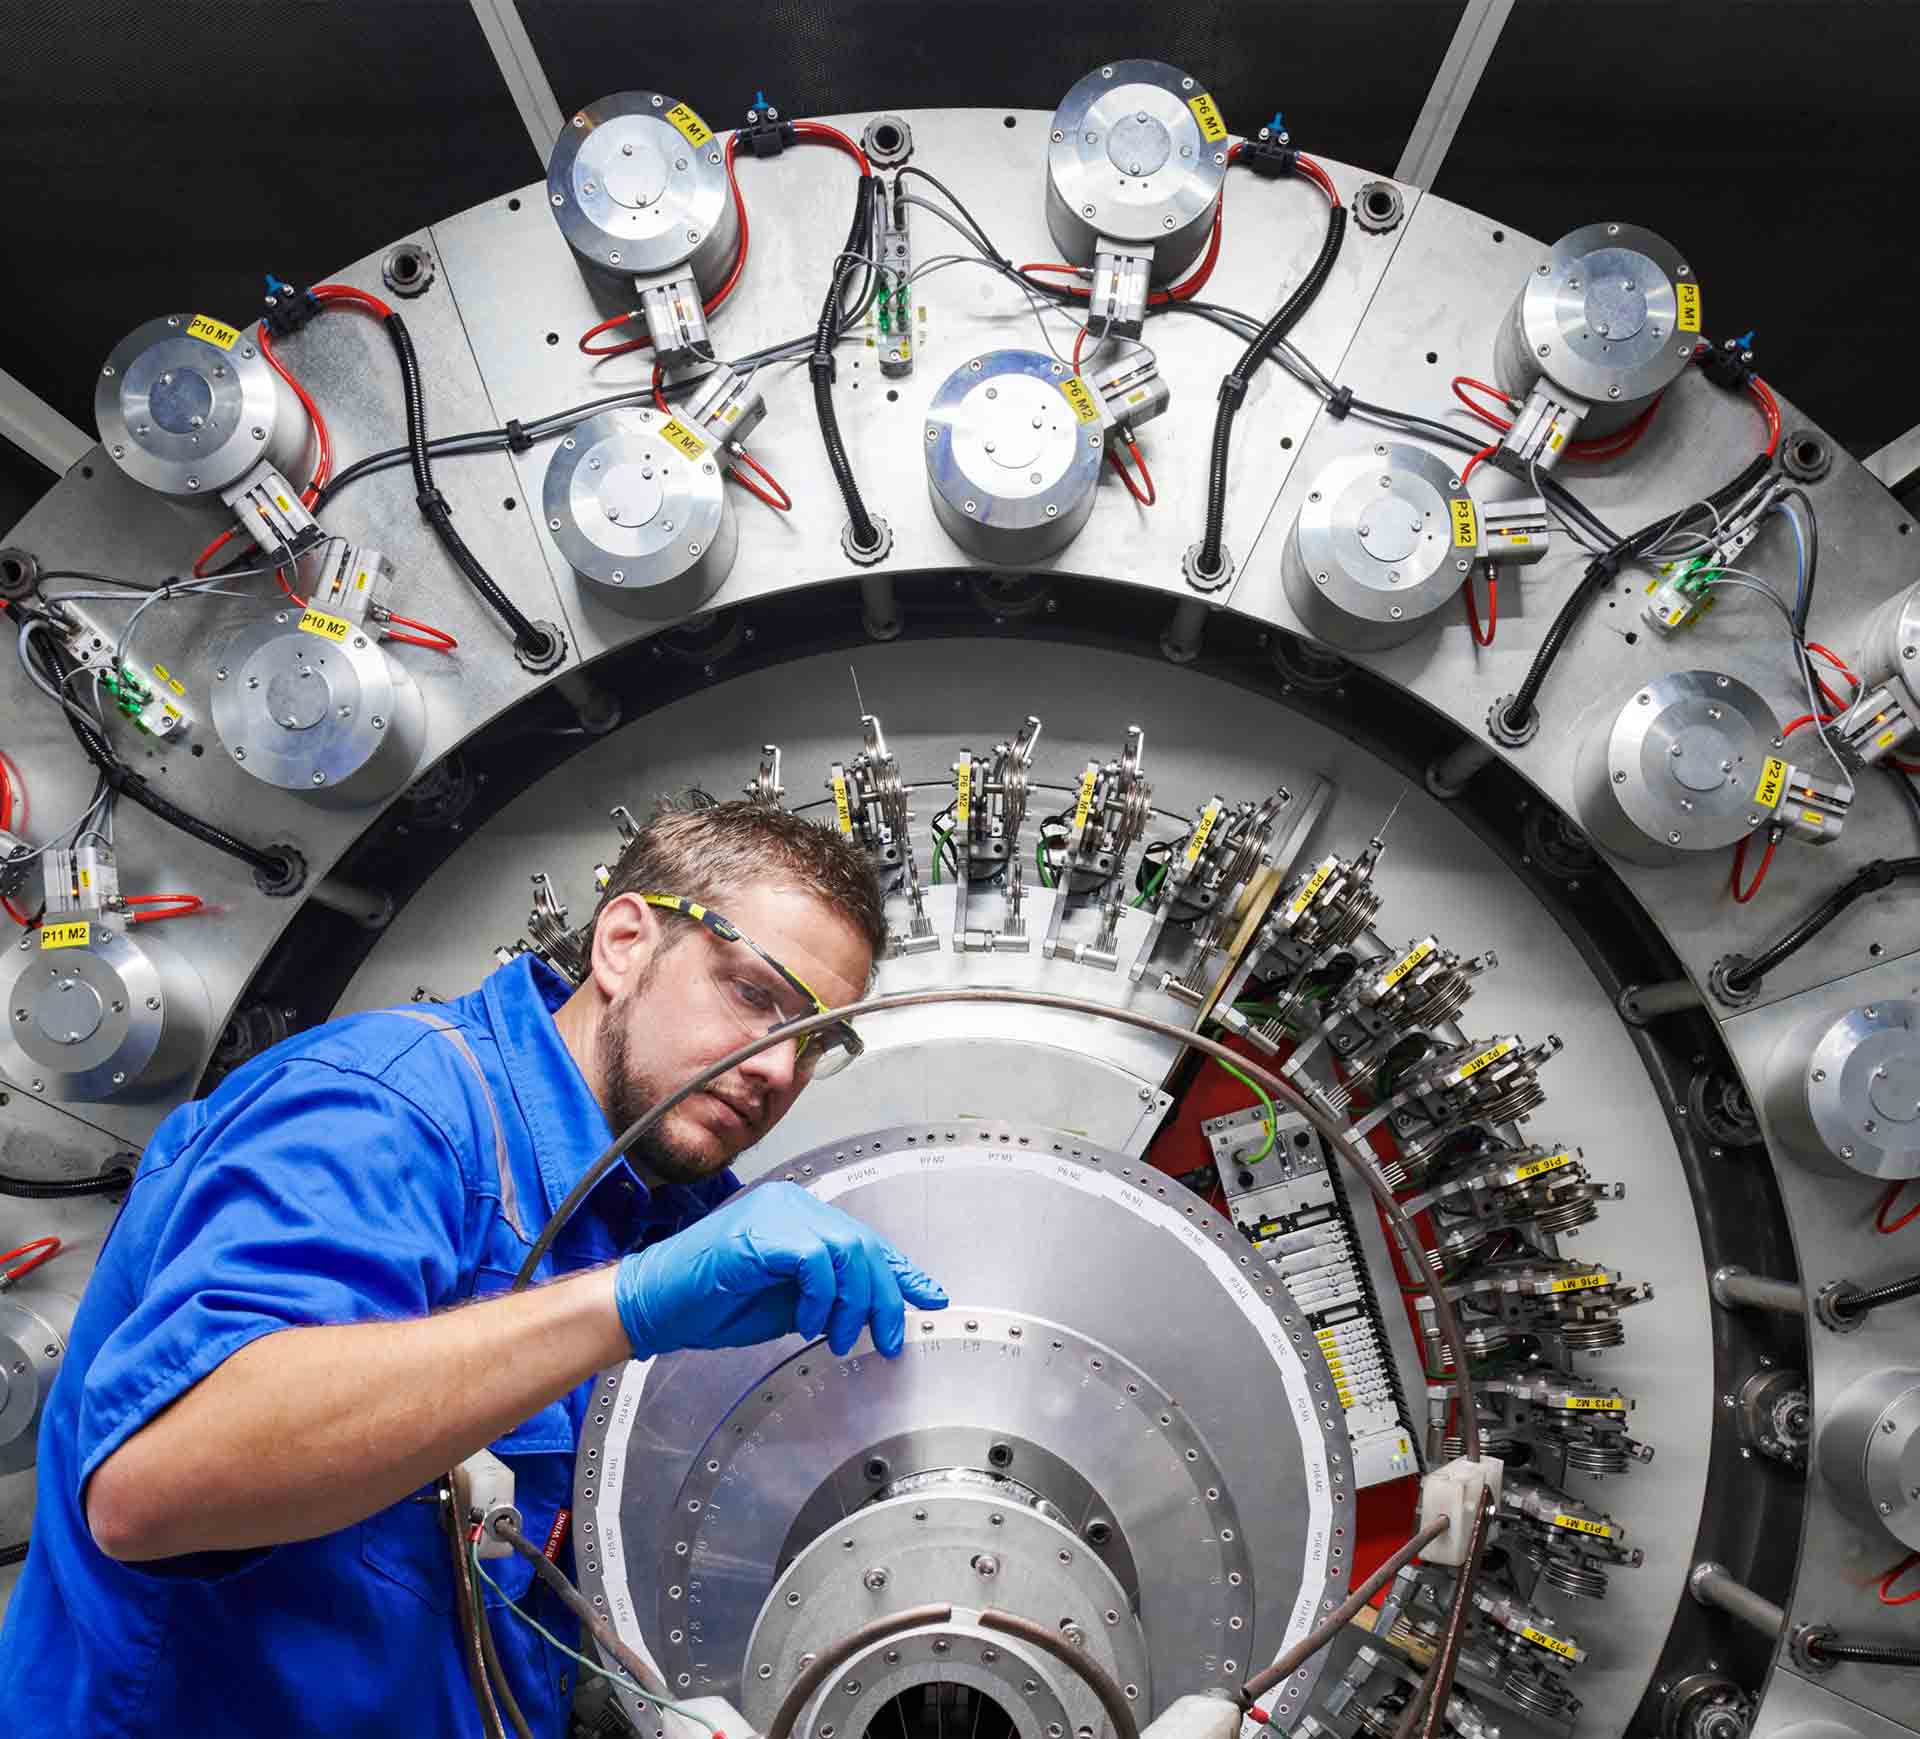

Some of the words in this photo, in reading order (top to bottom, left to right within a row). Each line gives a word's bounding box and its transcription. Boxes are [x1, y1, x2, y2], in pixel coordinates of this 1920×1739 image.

[1195, 97, 1210, 114] P6
[1204, 117, 1220, 136] M1
[672, 107, 689, 122] P7
[687, 123, 706, 141] M1
[1684, 286, 1695, 303] P3
[1684, 307, 1695, 326] M1
[192, 319, 214, 336] P10
[215, 329, 234, 345] M1
[1066, 380, 1081, 397] P6
[1077, 399, 1094, 417] M2
[664, 421, 683, 437] P7
[1457, 501, 1469, 518] P3
[1460, 523, 1472, 543] M2
[302, 613, 325, 629] P10
[326, 622, 347, 636] M2
[1769, 760, 1782, 778] P2
[1761, 781, 1777, 802] M2
[1200, 819, 1211, 832] P3
[1192, 835, 1204, 849] M2
[1311, 873, 1324, 887] P3
[1301, 889, 1313, 902] M1
[43, 930, 64, 943] P11
[68, 928, 87, 940] M2
[1408, 952, 1422, 965] P2
[1394, 964, 1408, 977] M2
[1487, 1050, 1500, 1061] P2
[1471, 1057, 1486, 1071] M1
[1525, 1164, 1542, 1175] M2
[1543, 1157, 1562, 1169] P16
[1562, 1280, 1577, 1290] M1
[1580, 1277, 1599, 1287] P16
[1575, 1399, 1591, 1408] M2
[1594, 1399, 1614, 1409] P13
[552, 1512, 567, 1538] WING
[1565, 1518, 1580, 1529] M1
[1583, 1521, 1602, 1534] P13
[1530, 1632, 1547, 1645] M2
[1549, 1640, 1568, 1654] P12
